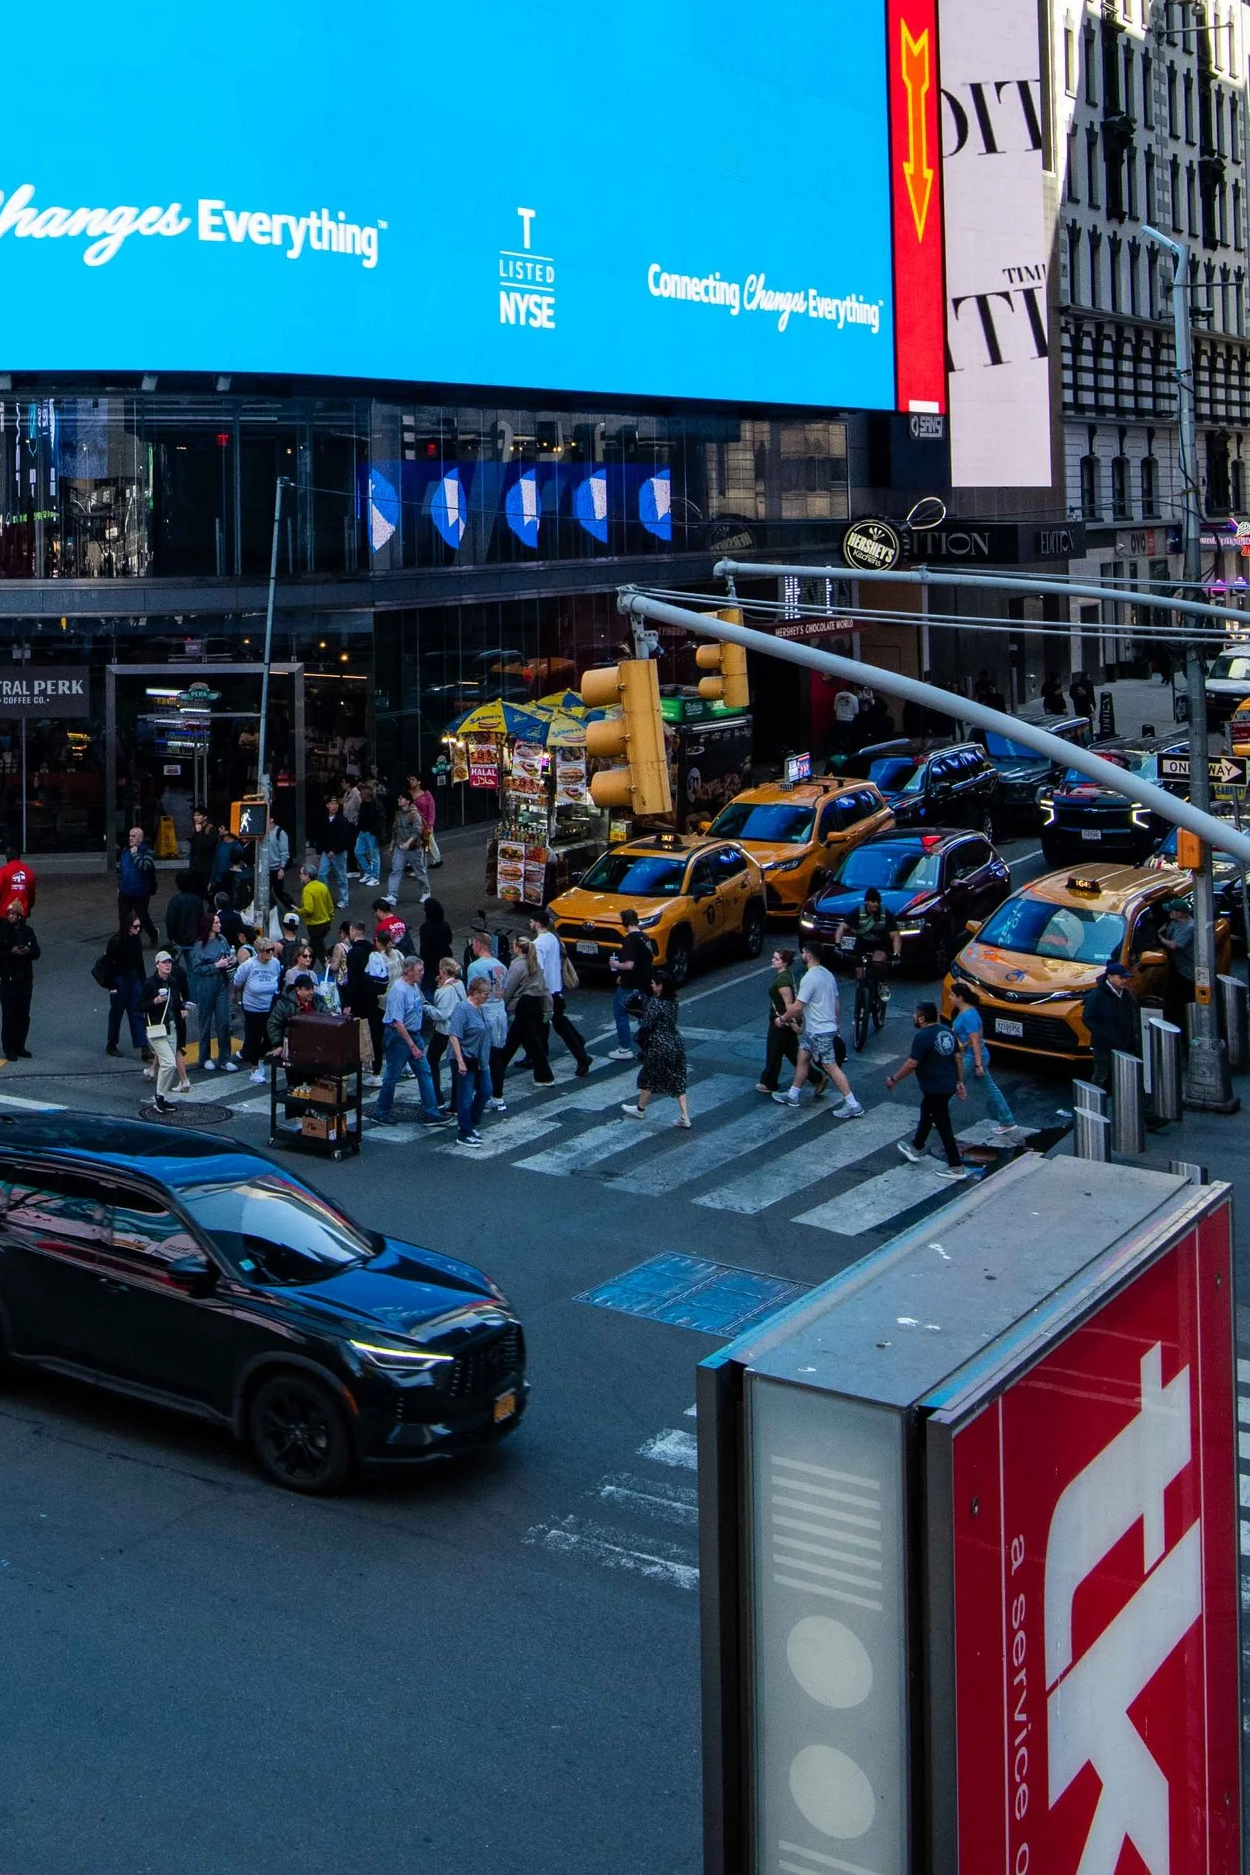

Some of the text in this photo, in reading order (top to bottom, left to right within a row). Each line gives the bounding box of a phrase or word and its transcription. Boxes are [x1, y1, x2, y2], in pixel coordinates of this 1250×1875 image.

[516, 206, 536, 250] T
[498, 258, 556, 285] LISTED
[499, 291, 556, 330] NYSE
[647, 262, 741, 309] Connecting
[742, 271, 808, 333] Changes
[847, 531, 896, 565] HERSHEY'S
[775, 625, 804, 637] HERSHEY'S
[805, 622, 836, 635] CHOCOLATE
[3, 696, 47, 705] COFFEE CO.
[33, 679, 85, 696] PERK
[471, 767, 496, 776] HALAL
[1008, 1534, 1024, 1576] a
[1009, 1596, 1030, 1823] service
